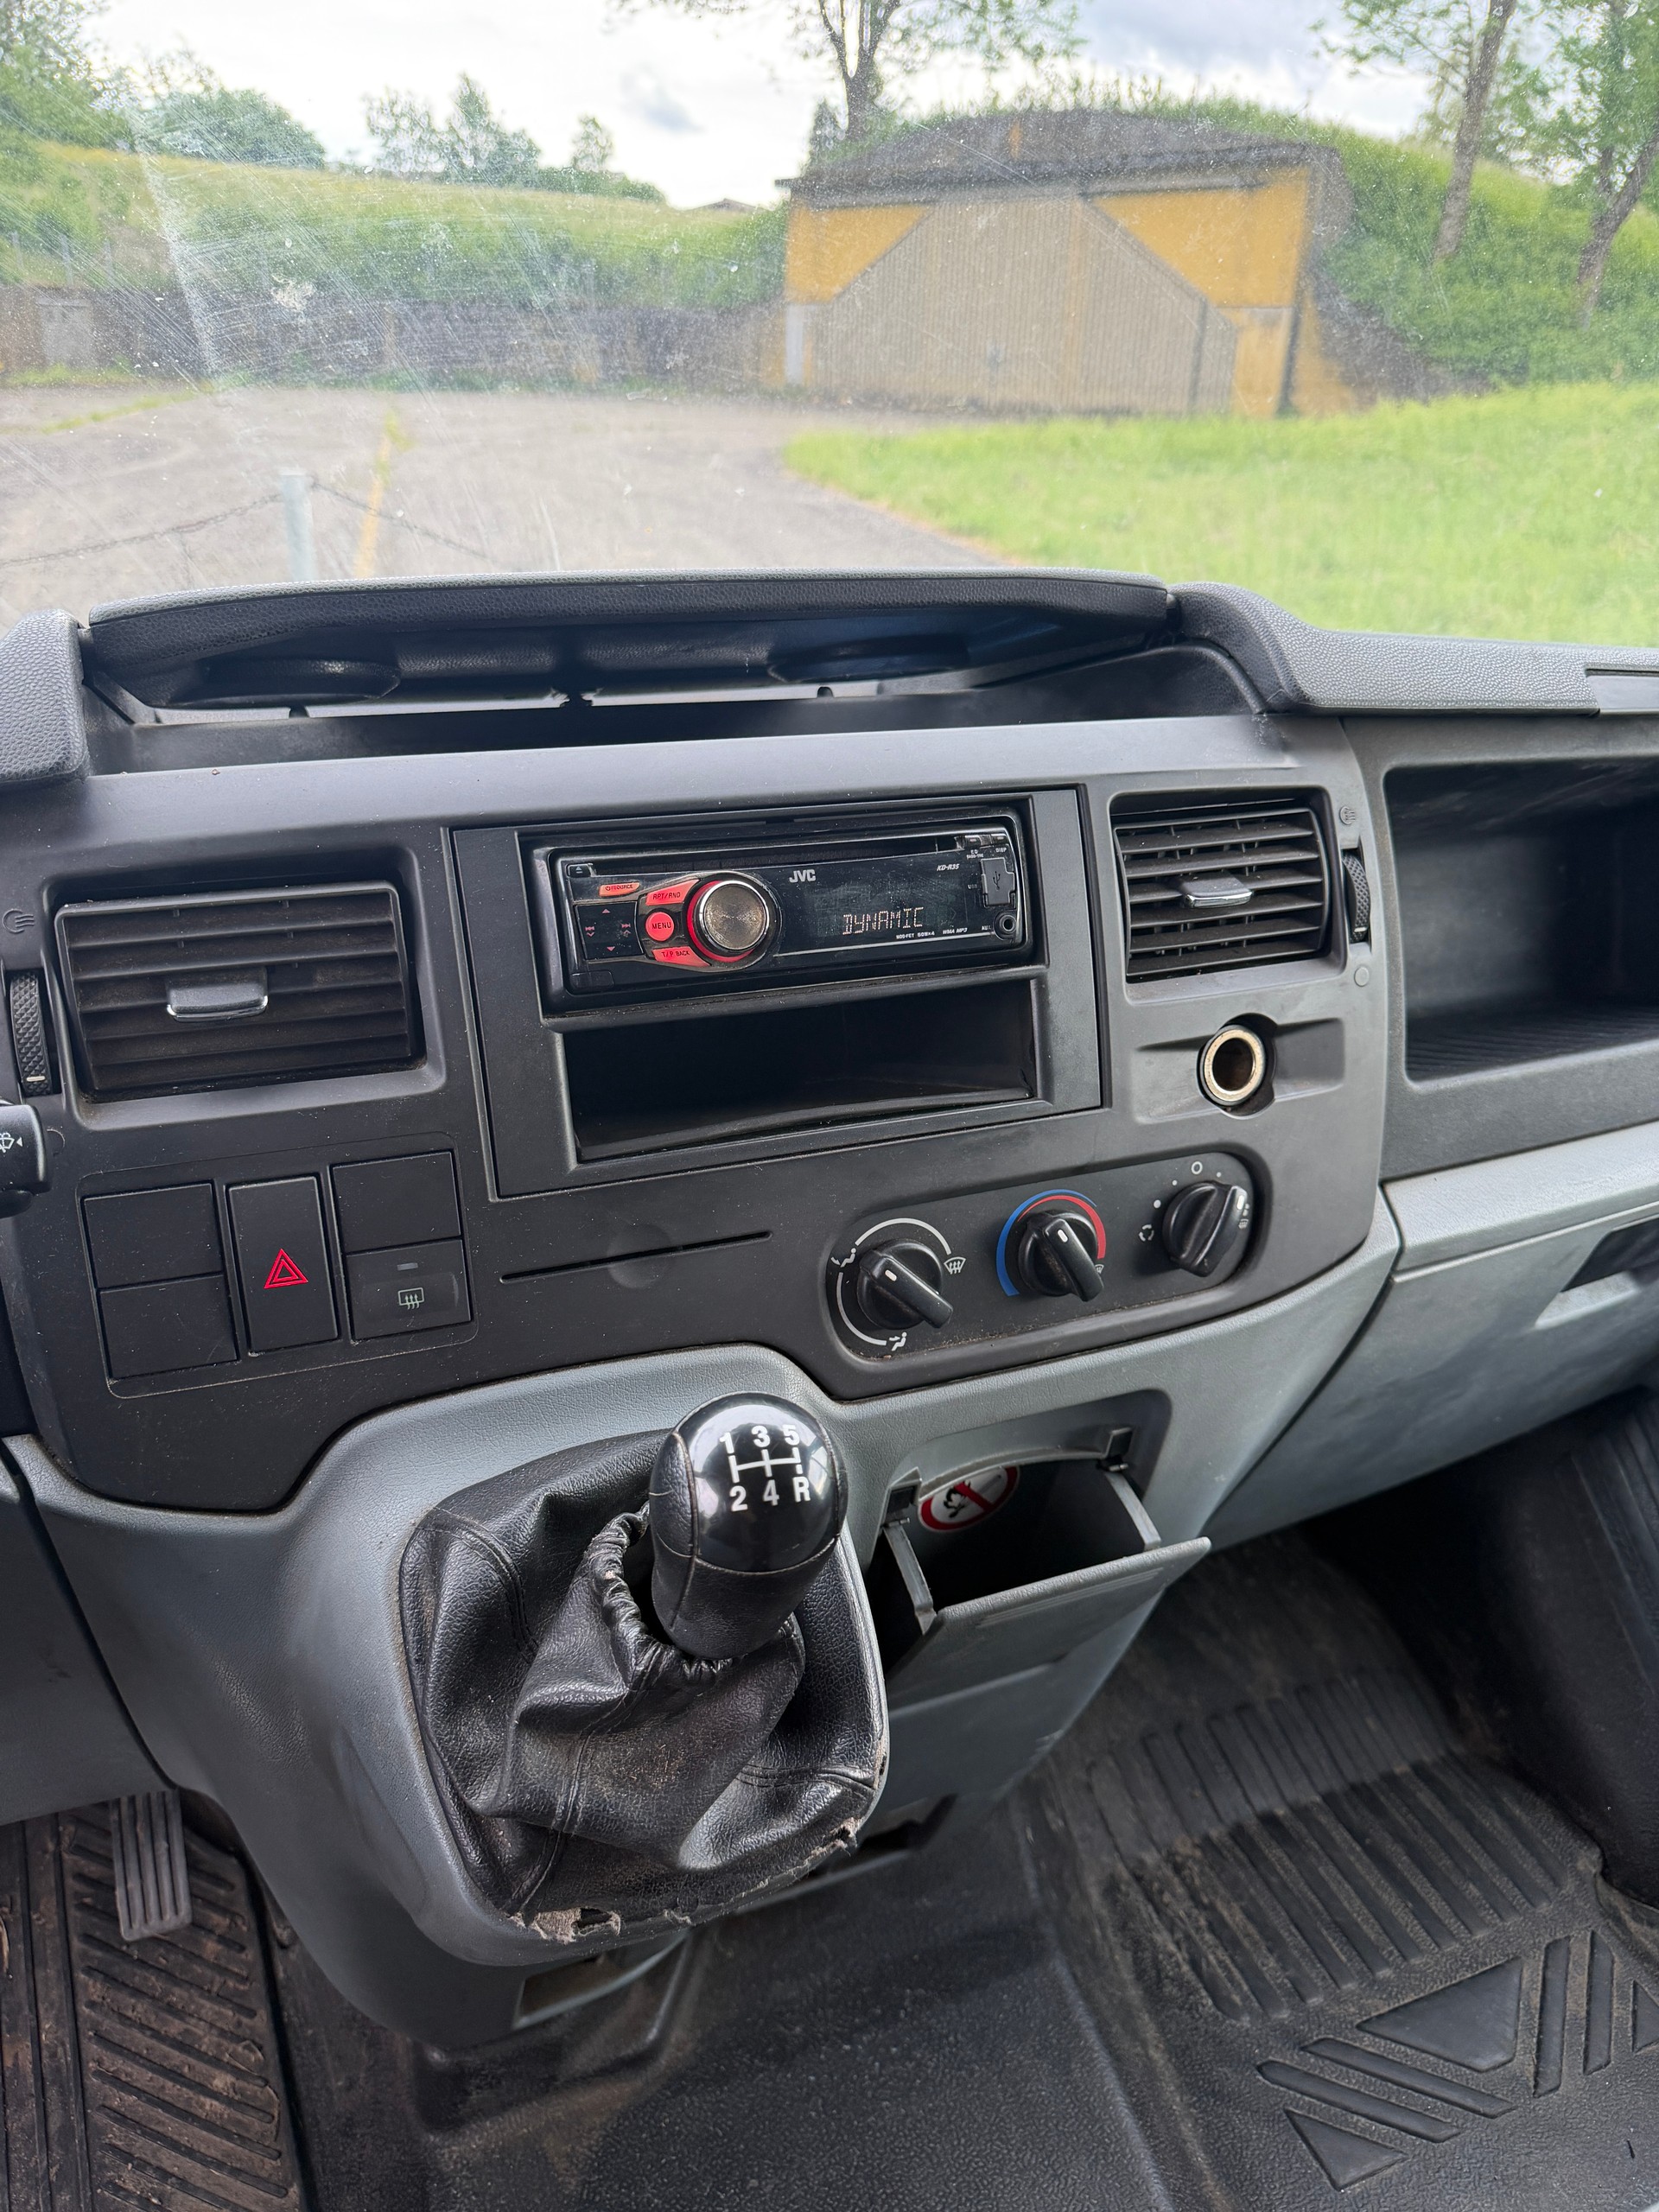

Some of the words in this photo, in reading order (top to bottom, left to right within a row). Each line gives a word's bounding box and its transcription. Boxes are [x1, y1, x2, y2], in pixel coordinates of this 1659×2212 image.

[937, 863, 960, 872] KD-R35
[789, 869, 817, 883] JVC
[652, 892, 681, 900] RPT/RND
[652, 921, 671, 930] MENU
[842, 906, 924, 936] DYNAMIC
[719, 1432, 734, 1454] 1
[751, 1425, 771, 1448] 3
[782, 1424, 800, 1446] 5
[729, 1485, 748, 1512] 2
[762, 1479, 780, 1506] 4
[792, 1476, 811, 1503] R
